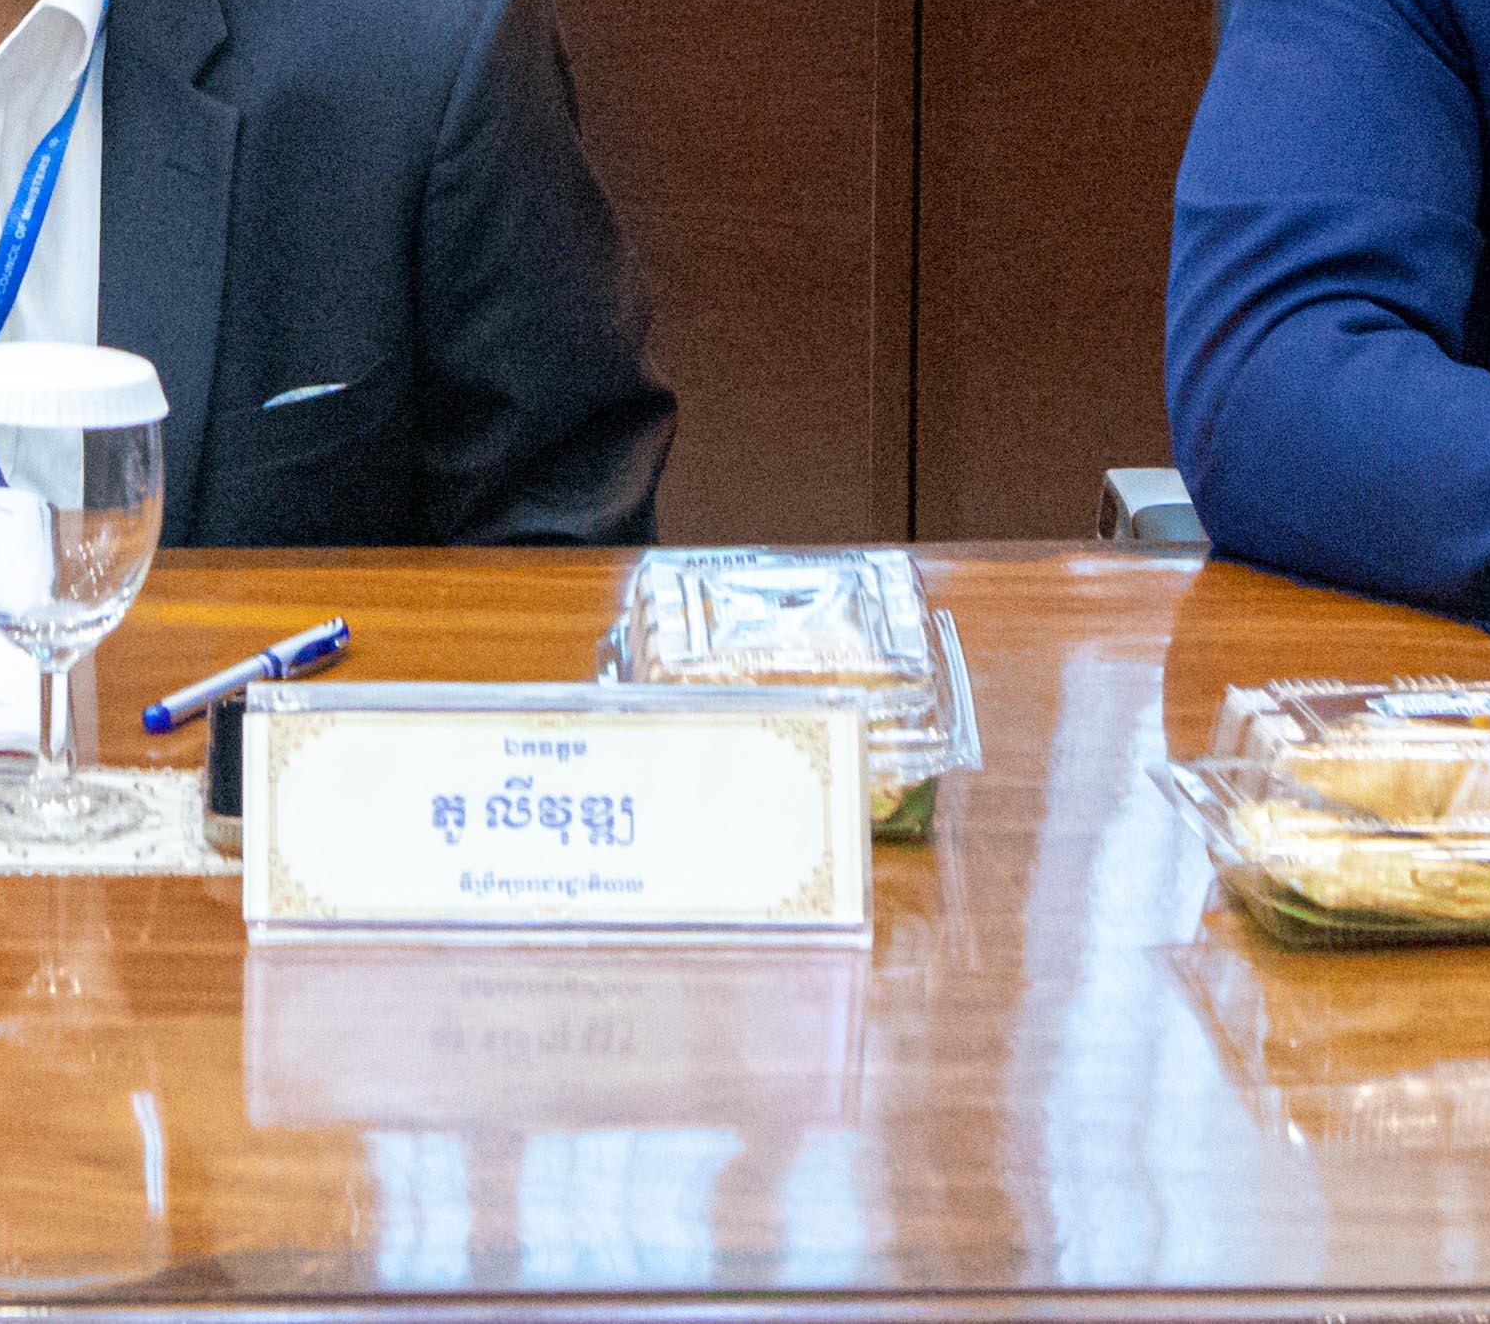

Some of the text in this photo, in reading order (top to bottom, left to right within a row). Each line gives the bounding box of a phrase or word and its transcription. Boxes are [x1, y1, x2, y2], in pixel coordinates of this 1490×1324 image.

[13, 221, 28, 240] OF
[504, 737, 587, 763] ឯកឧត្តម
